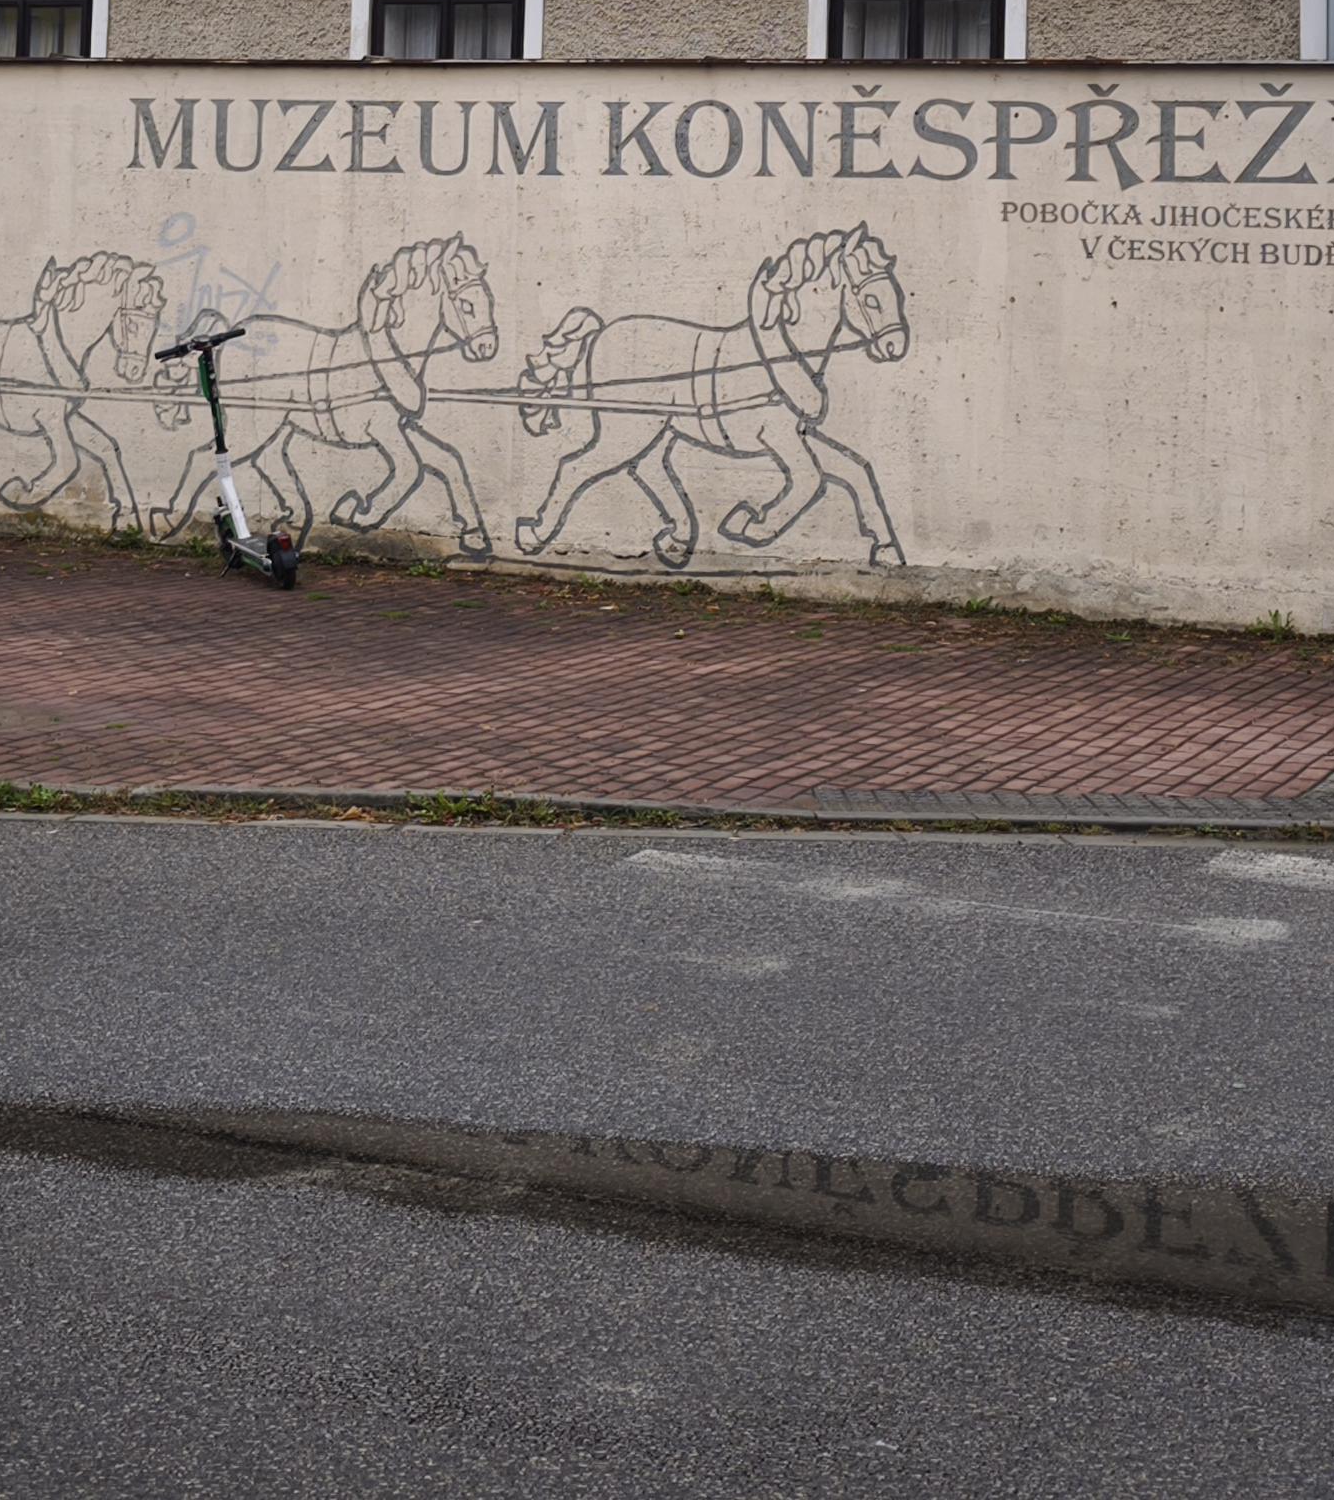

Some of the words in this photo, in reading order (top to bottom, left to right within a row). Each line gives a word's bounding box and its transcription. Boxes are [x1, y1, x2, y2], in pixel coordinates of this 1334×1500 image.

[126, 97, 566, 176] MUZEUM
[1000, 200, 1143, 226] POBOČKA
[1080, 234, 1103, 260] V
[1108, 235, 1250, 265] ČESKÝCH
